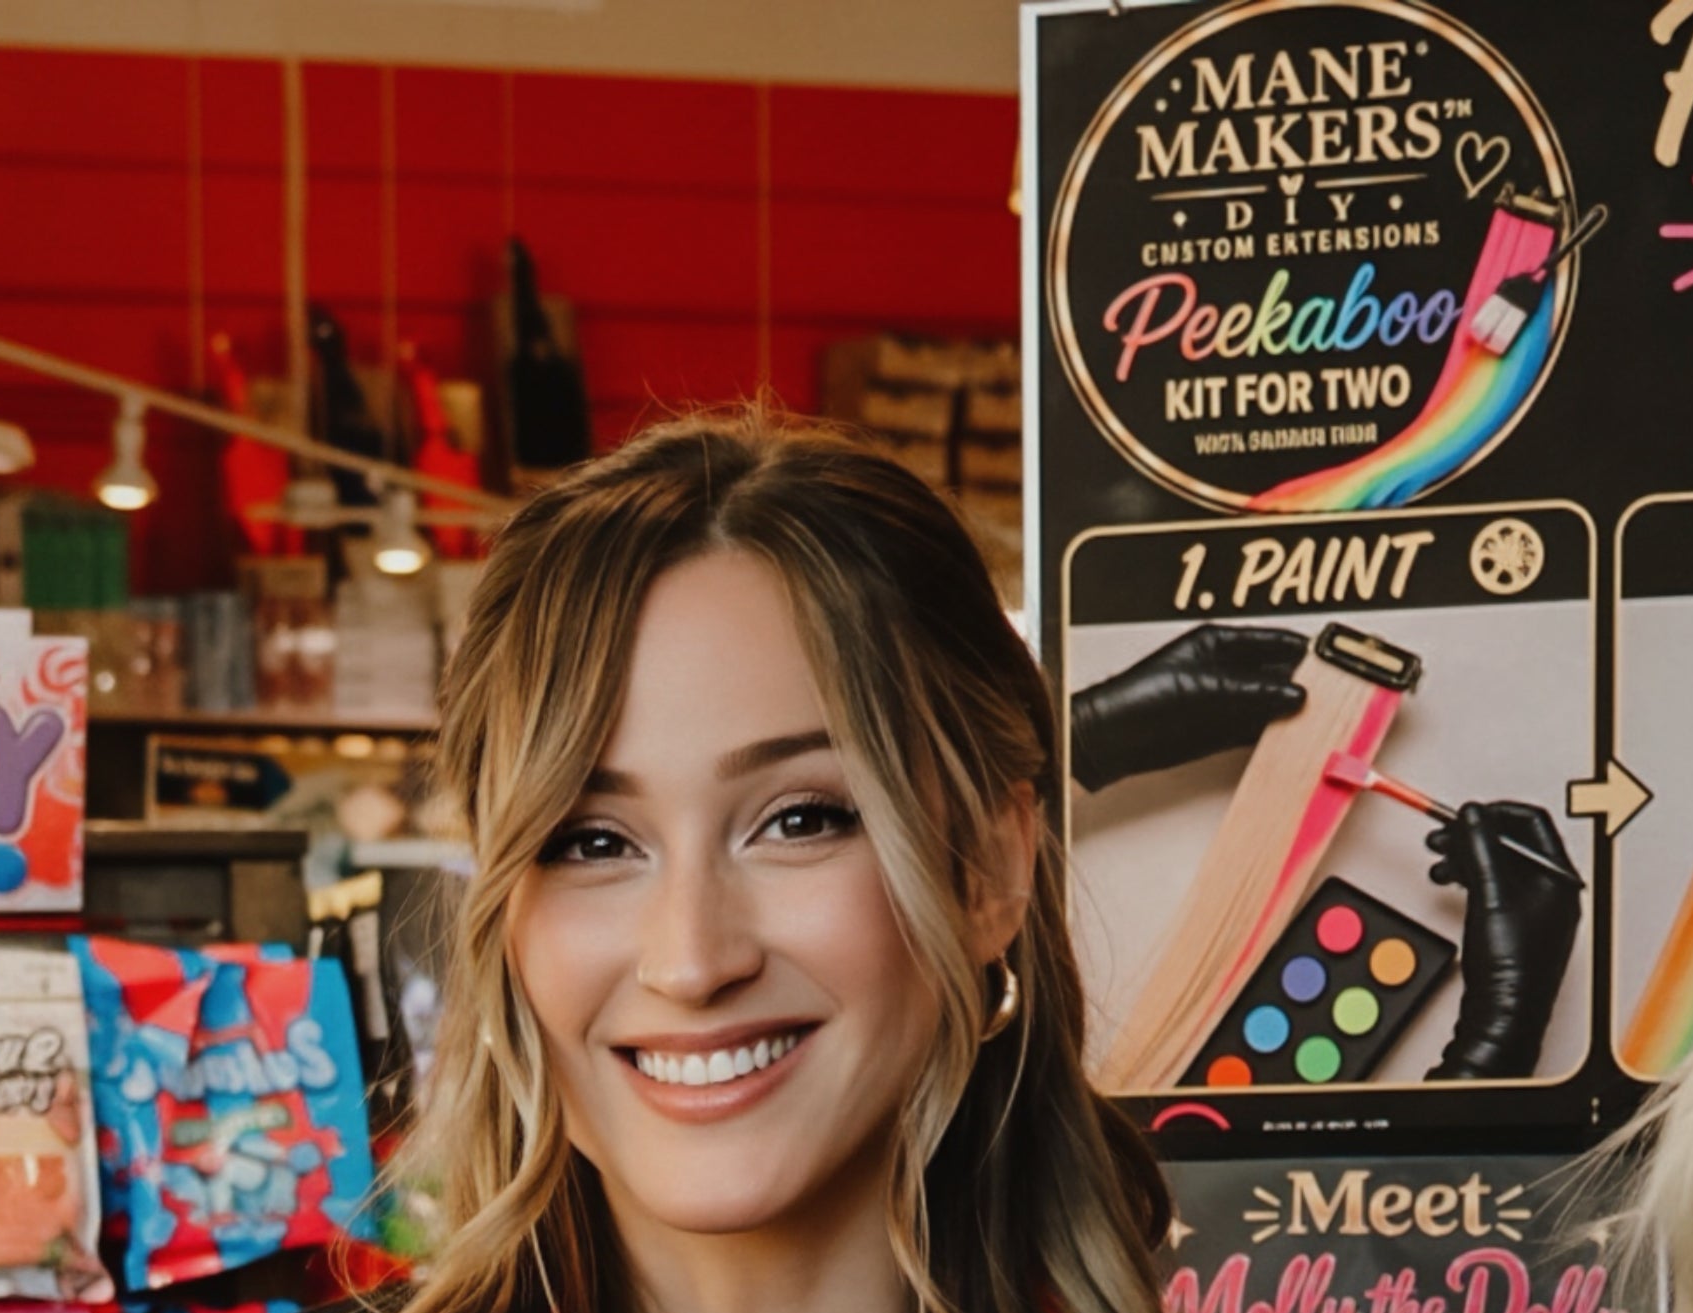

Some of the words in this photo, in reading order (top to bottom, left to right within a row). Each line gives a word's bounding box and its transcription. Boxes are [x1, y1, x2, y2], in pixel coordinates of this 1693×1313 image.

[1191, 42, 1411, 114] MANE
[1103, 261, 1464, 383] Peekaboo
[1164, 378, 1228, 422] KIT
[1235, 371, 1313, 418] FOR
[1320, 364, 1411, 412] TWO
[1231, 531, 1436, 607] PAINT
[1286, 1169, 1491, 1237] Meet
